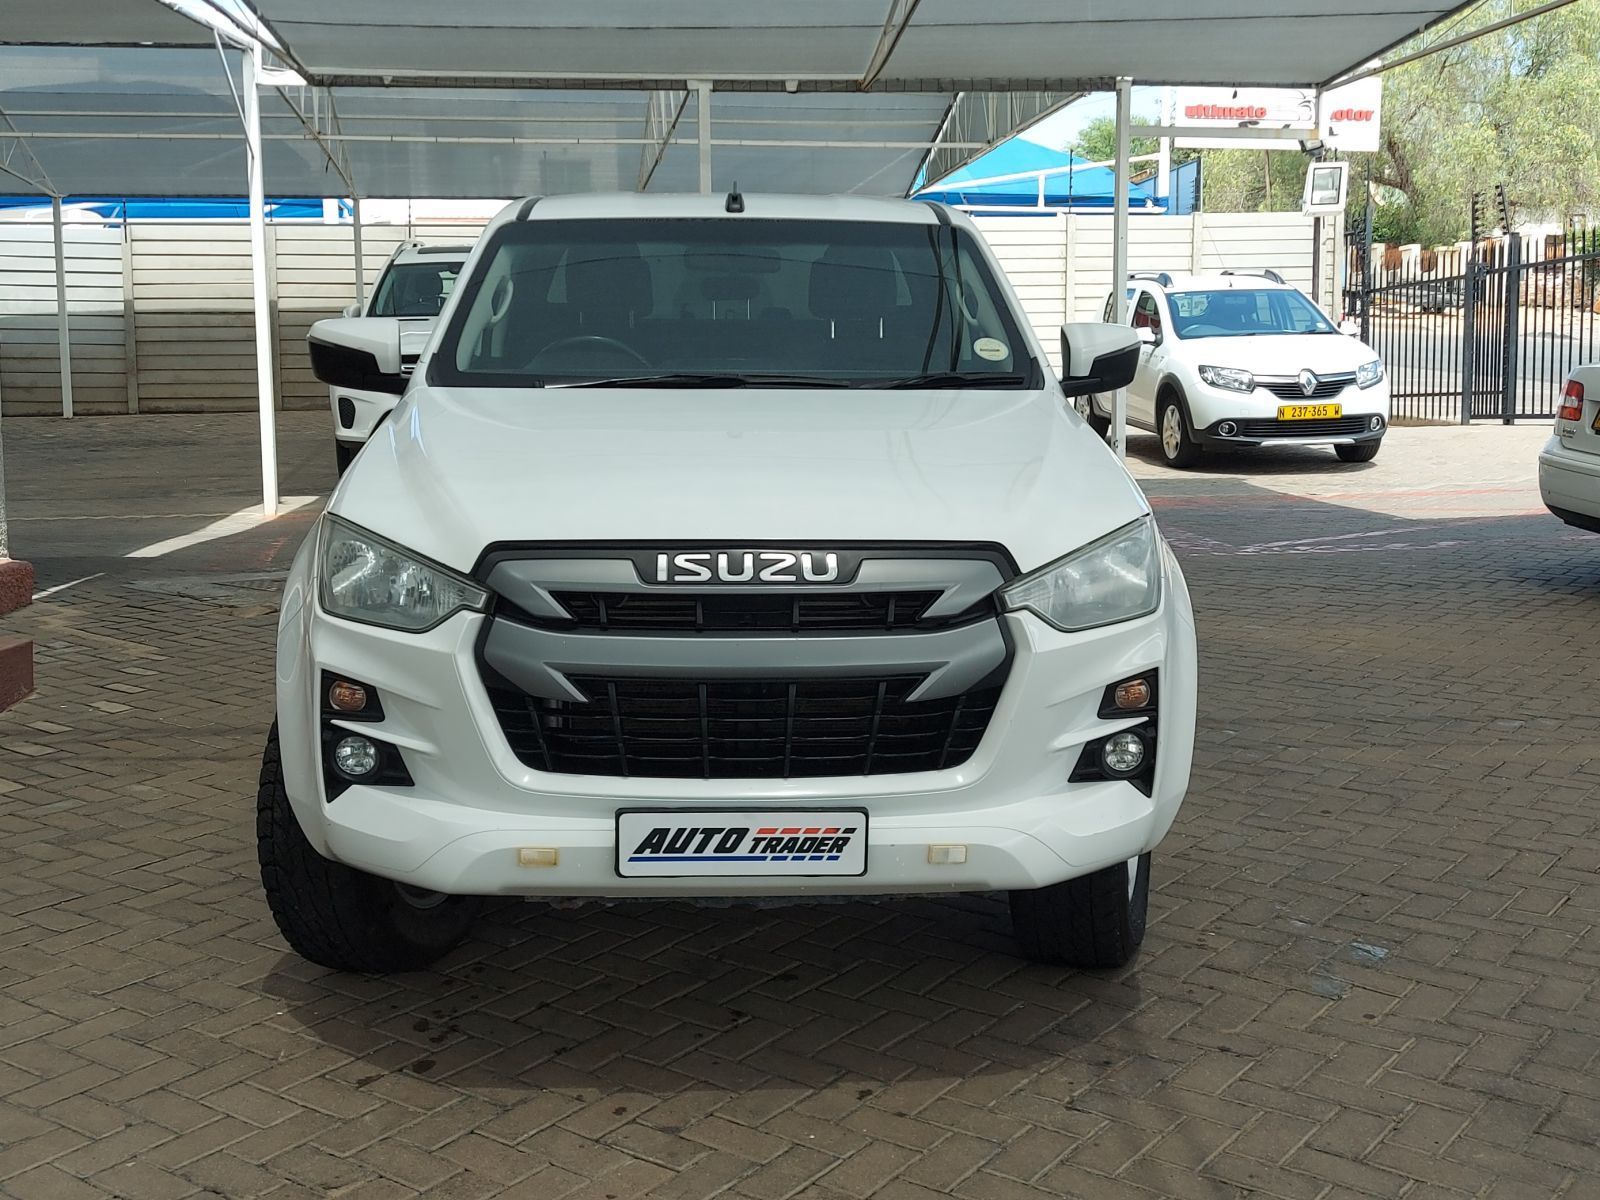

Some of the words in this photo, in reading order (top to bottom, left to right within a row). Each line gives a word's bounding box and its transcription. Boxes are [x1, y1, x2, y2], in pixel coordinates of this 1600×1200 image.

[1185, 104, 1267, 118] ultimate
[1330, 108, 1374, 121] otor
[1280, 408, 1285, 418] N
[1291, 405, 1328, 417] 237-365
[656, 553, 839, 582] ISUZU
[632, 827, 750, 855] AUTO
[748, 836, 851, 854] TRADER
